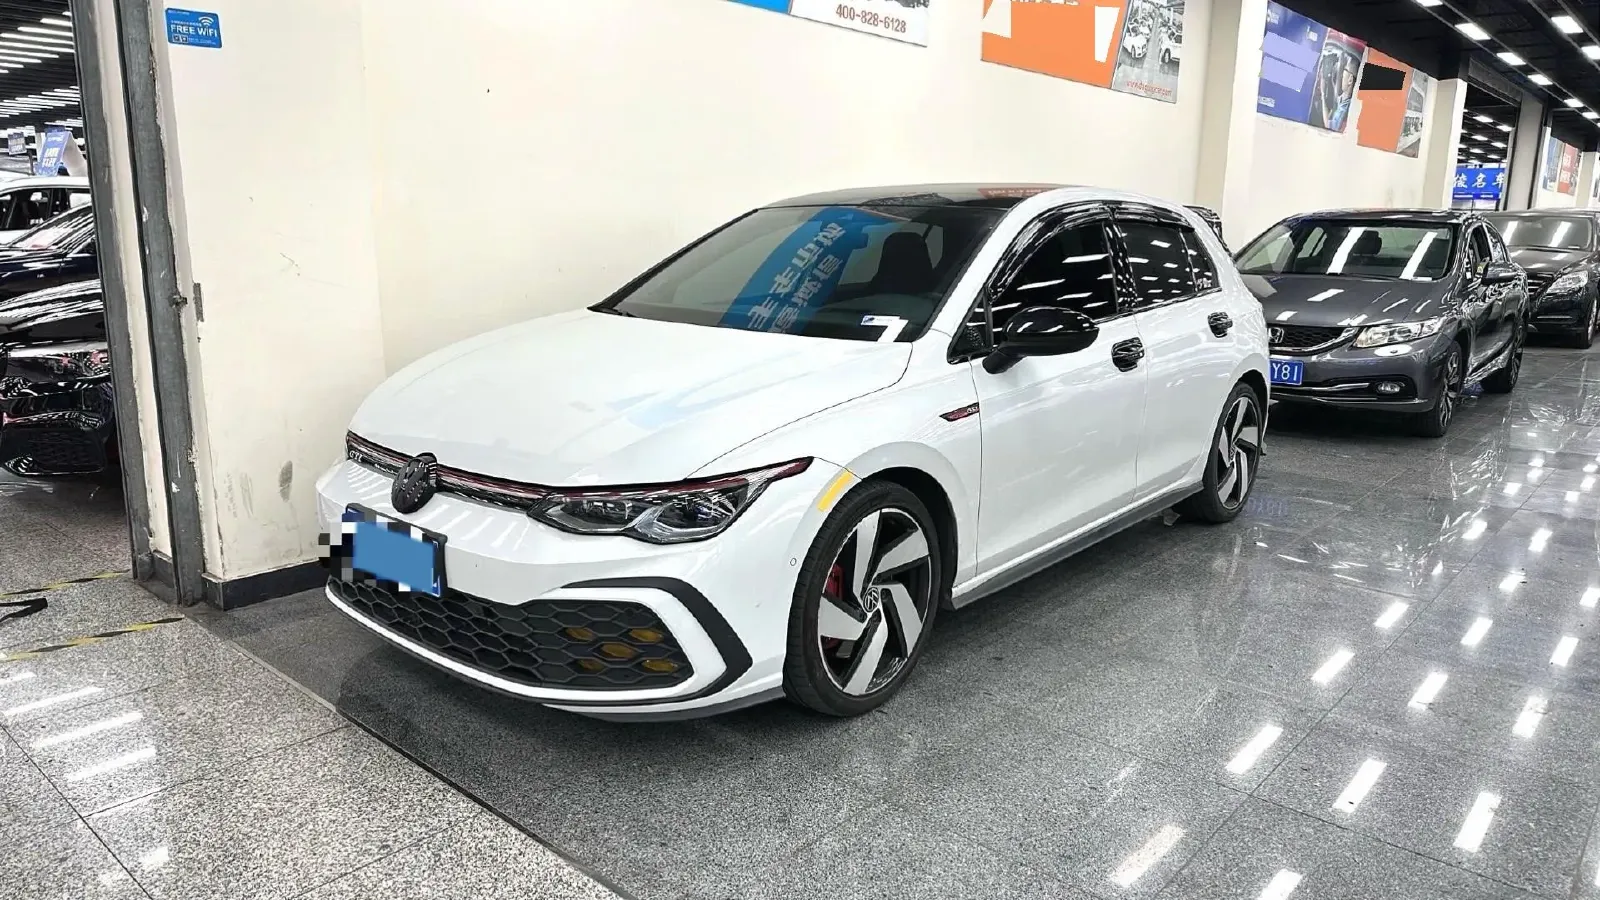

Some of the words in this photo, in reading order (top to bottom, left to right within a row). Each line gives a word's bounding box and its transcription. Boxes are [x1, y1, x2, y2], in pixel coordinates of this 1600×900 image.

[835, 3, 907, 34] 400-828-6128
[170, 24, 196, 35] FREE
[349, 450, 363, 463] GTI
